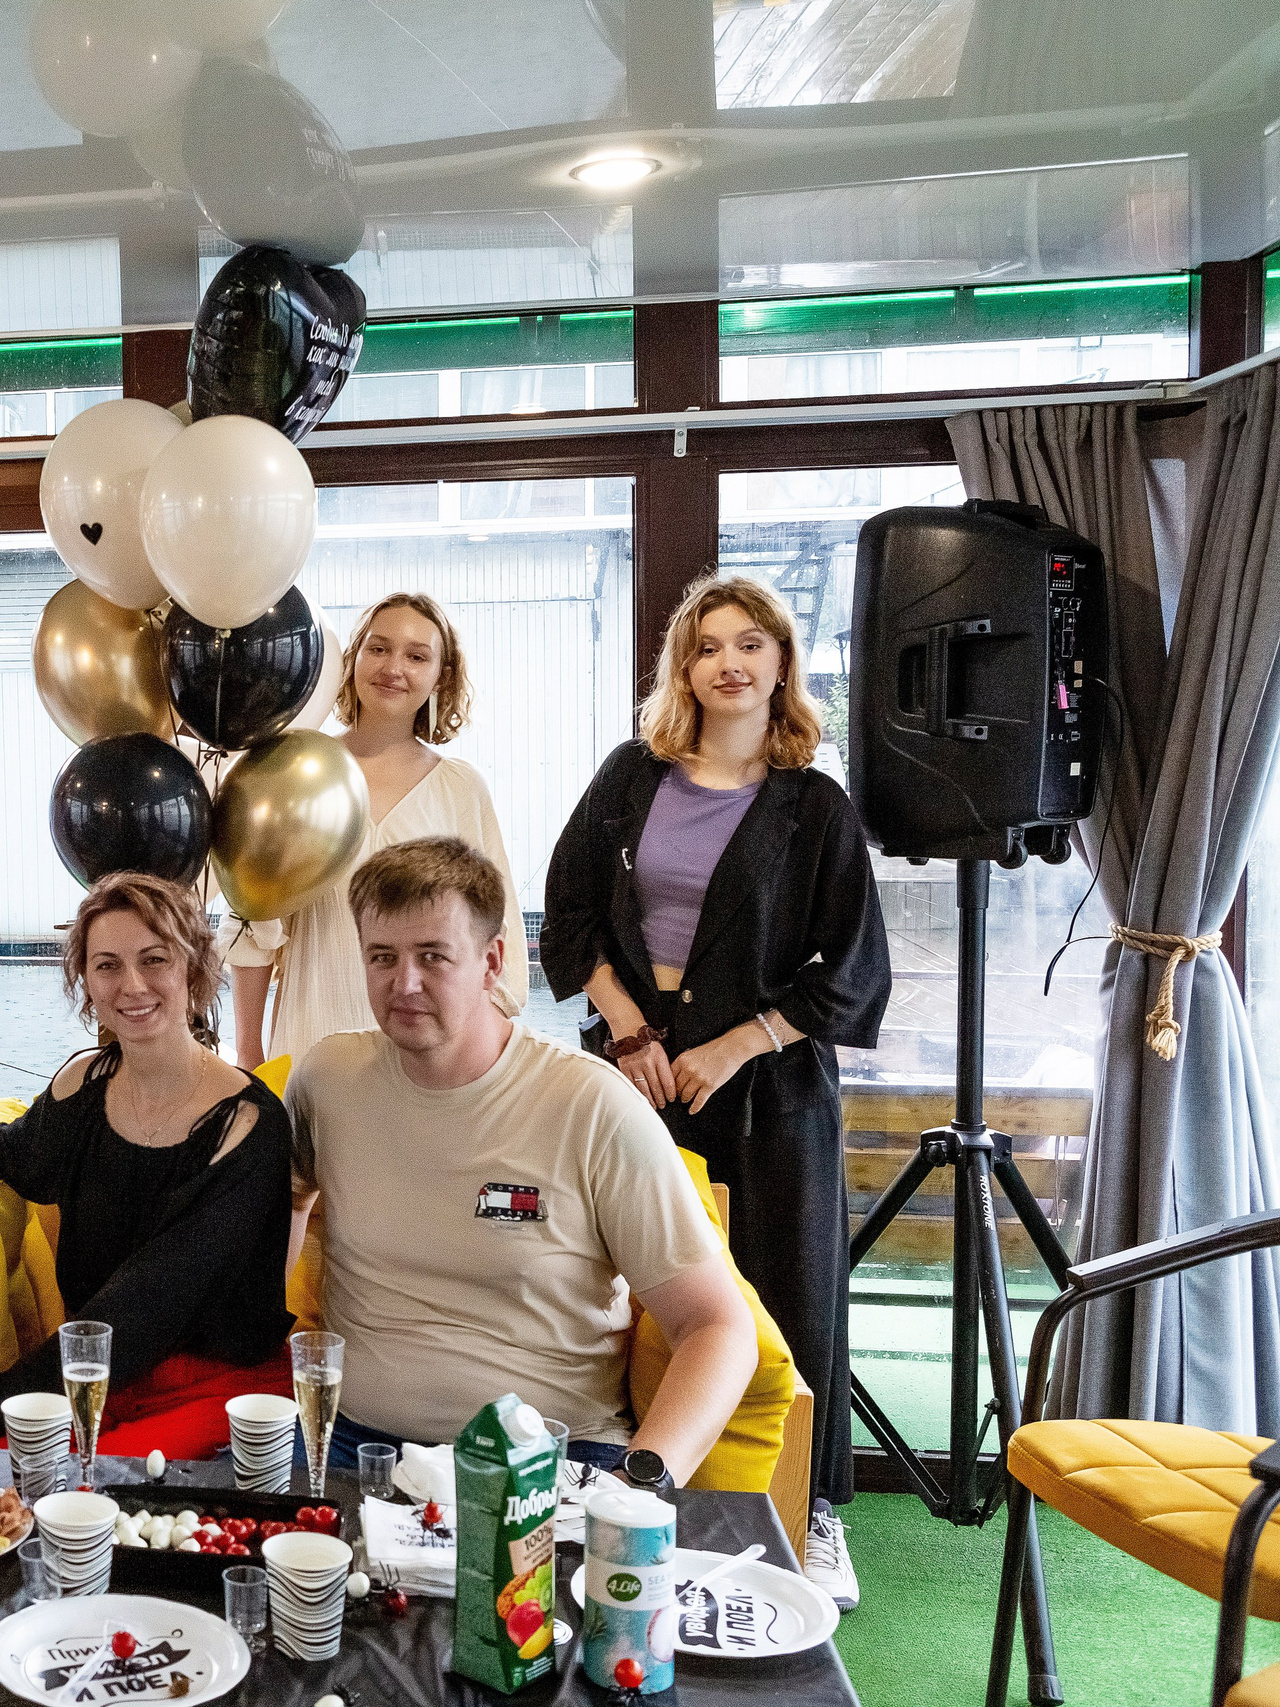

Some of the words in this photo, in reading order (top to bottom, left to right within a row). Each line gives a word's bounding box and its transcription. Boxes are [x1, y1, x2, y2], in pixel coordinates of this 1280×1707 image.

[340, 322, 350, 348] 18
[306, 345, 327, 365] как
[524, 1524, 554, 1551] 100%
[724, 1594, 756, 1633] ПОЕЛ
[725, 1633, 757, 1647] И
